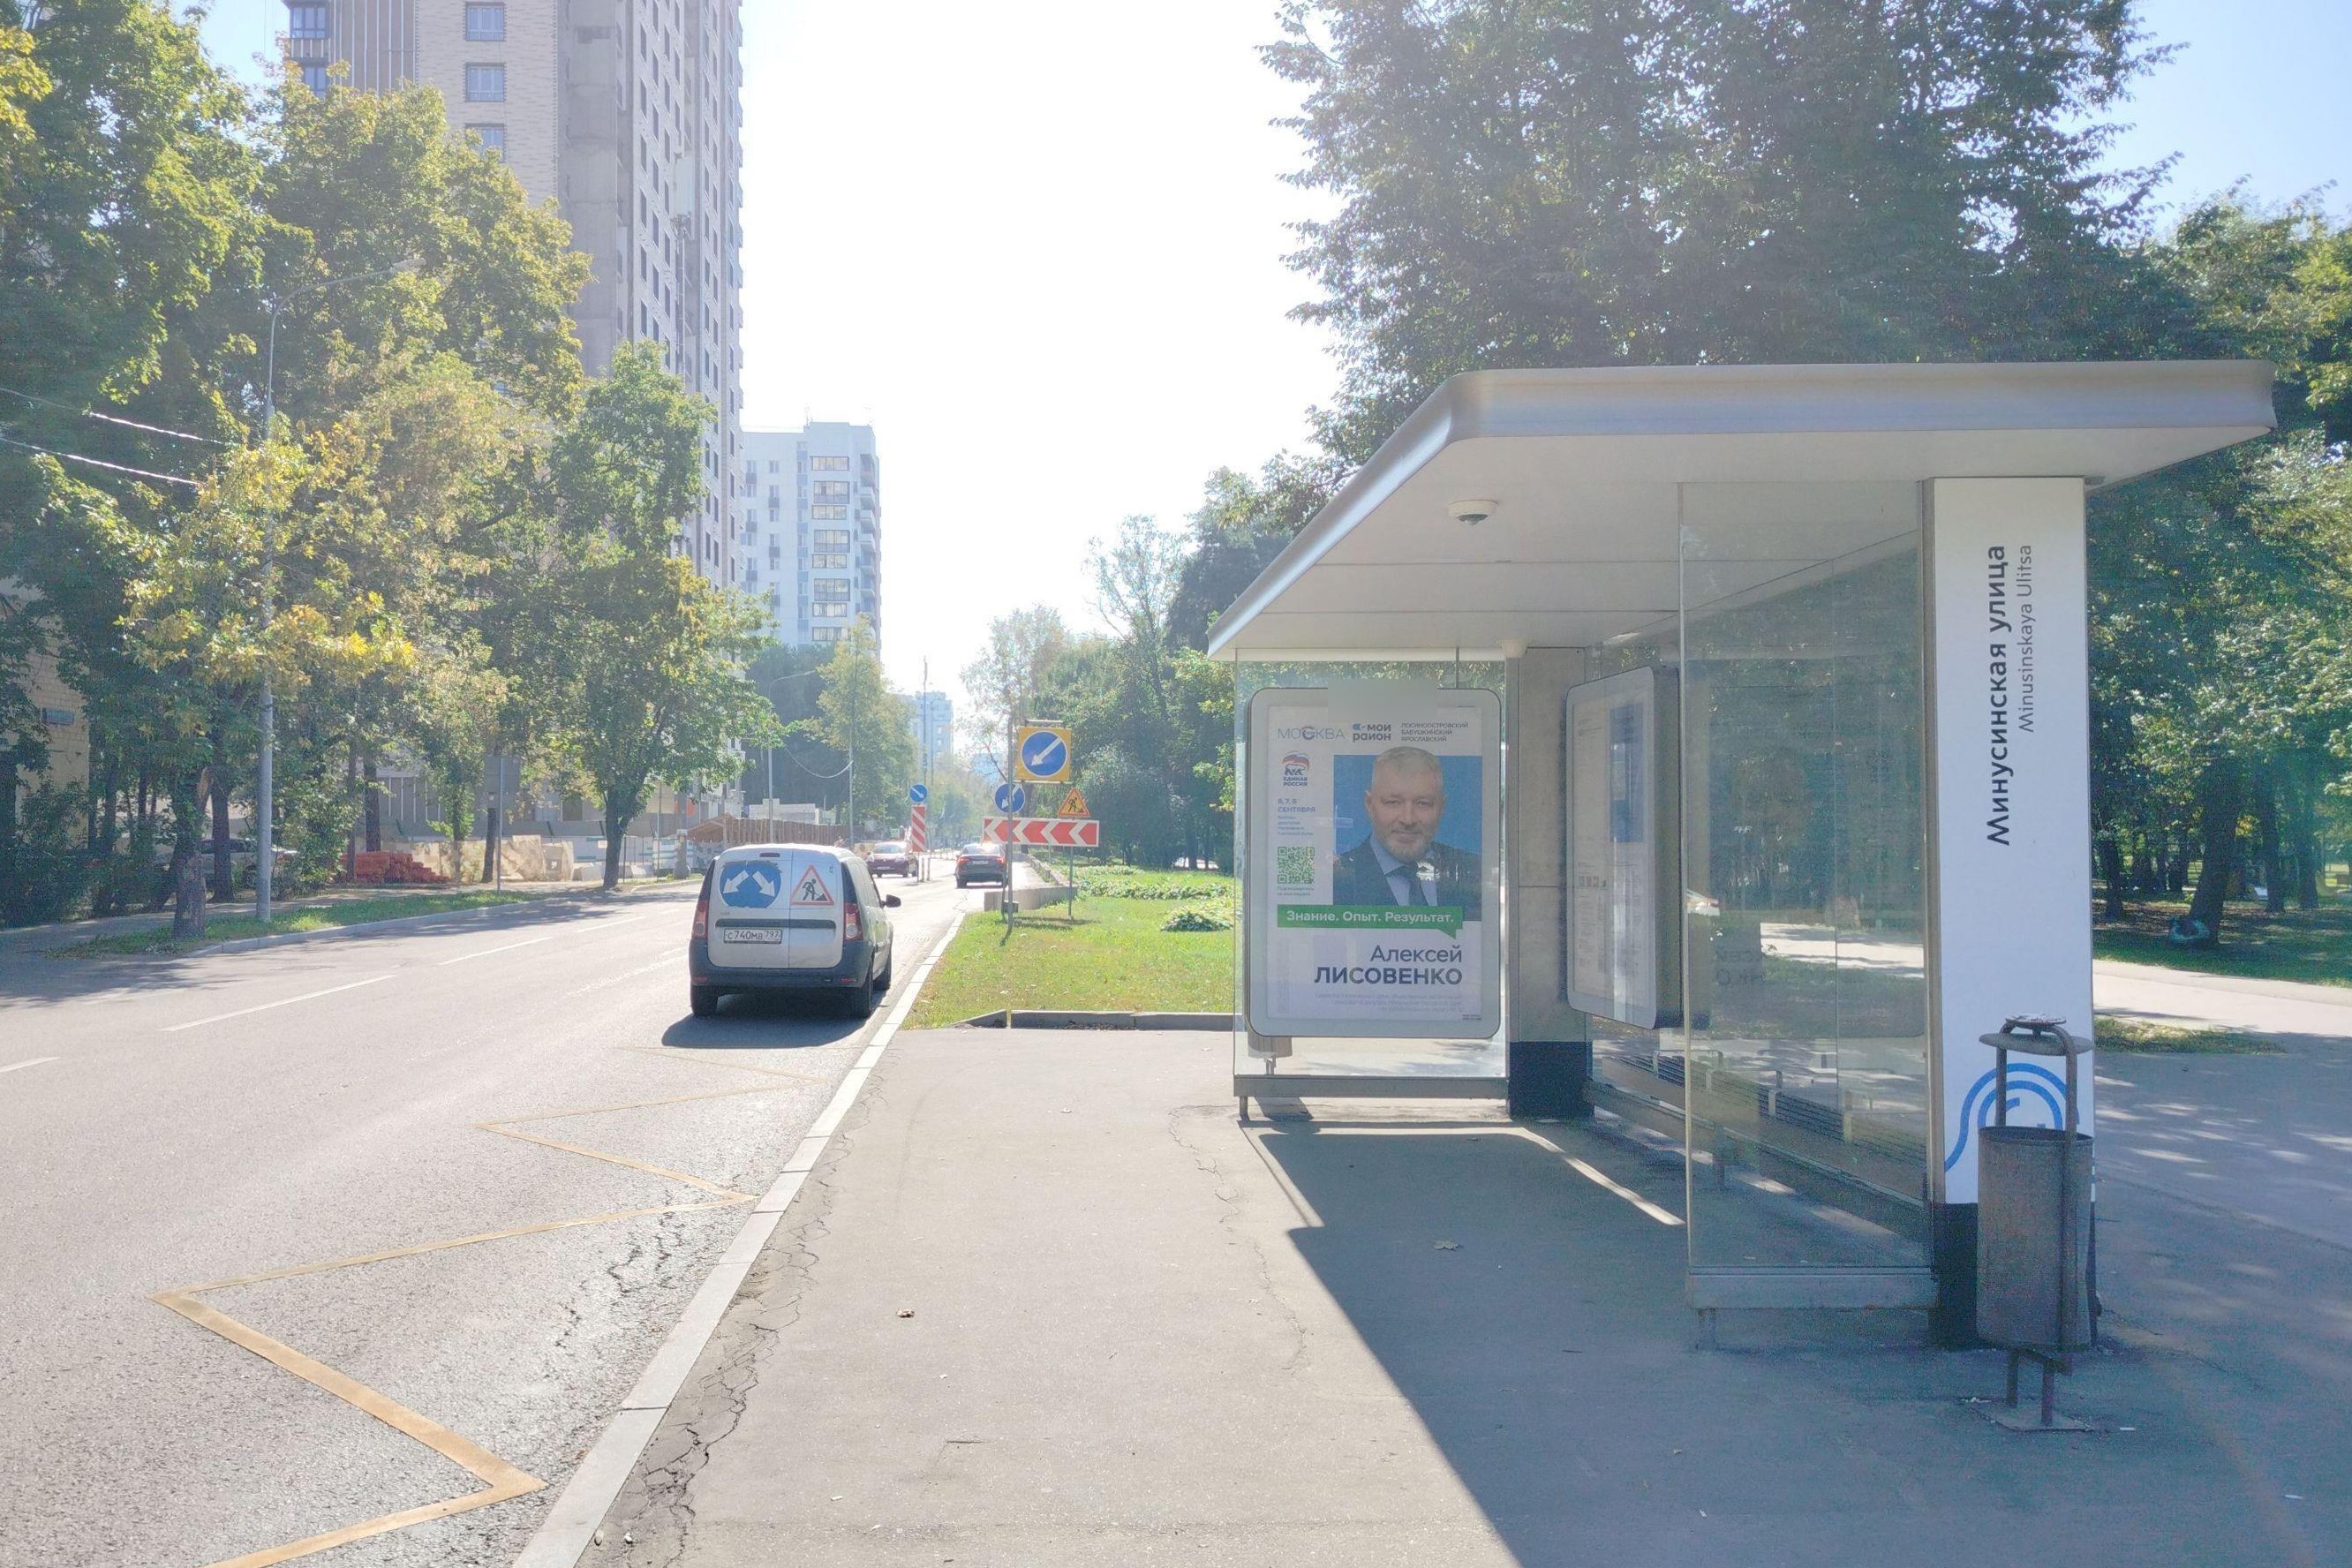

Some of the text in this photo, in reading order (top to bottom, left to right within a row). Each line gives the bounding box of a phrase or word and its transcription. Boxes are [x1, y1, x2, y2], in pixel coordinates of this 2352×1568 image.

[2016, 544, 2037, 734] Minusinskaya Ulitsa
[1986, 545, 2014, 847] Минусинская улица
[1277, 726, 1346, 740] МОСКВА
[1367, 721, 1391, 732] мой
[1353, 731, 1391, 743] район
[1286, 910, 1455, 924] Знание. Опыт. Результат.
[1370, 945, 1462, 963] Алексей
[1314, 967, 1463, 985] ЛИСОВЕНКО
